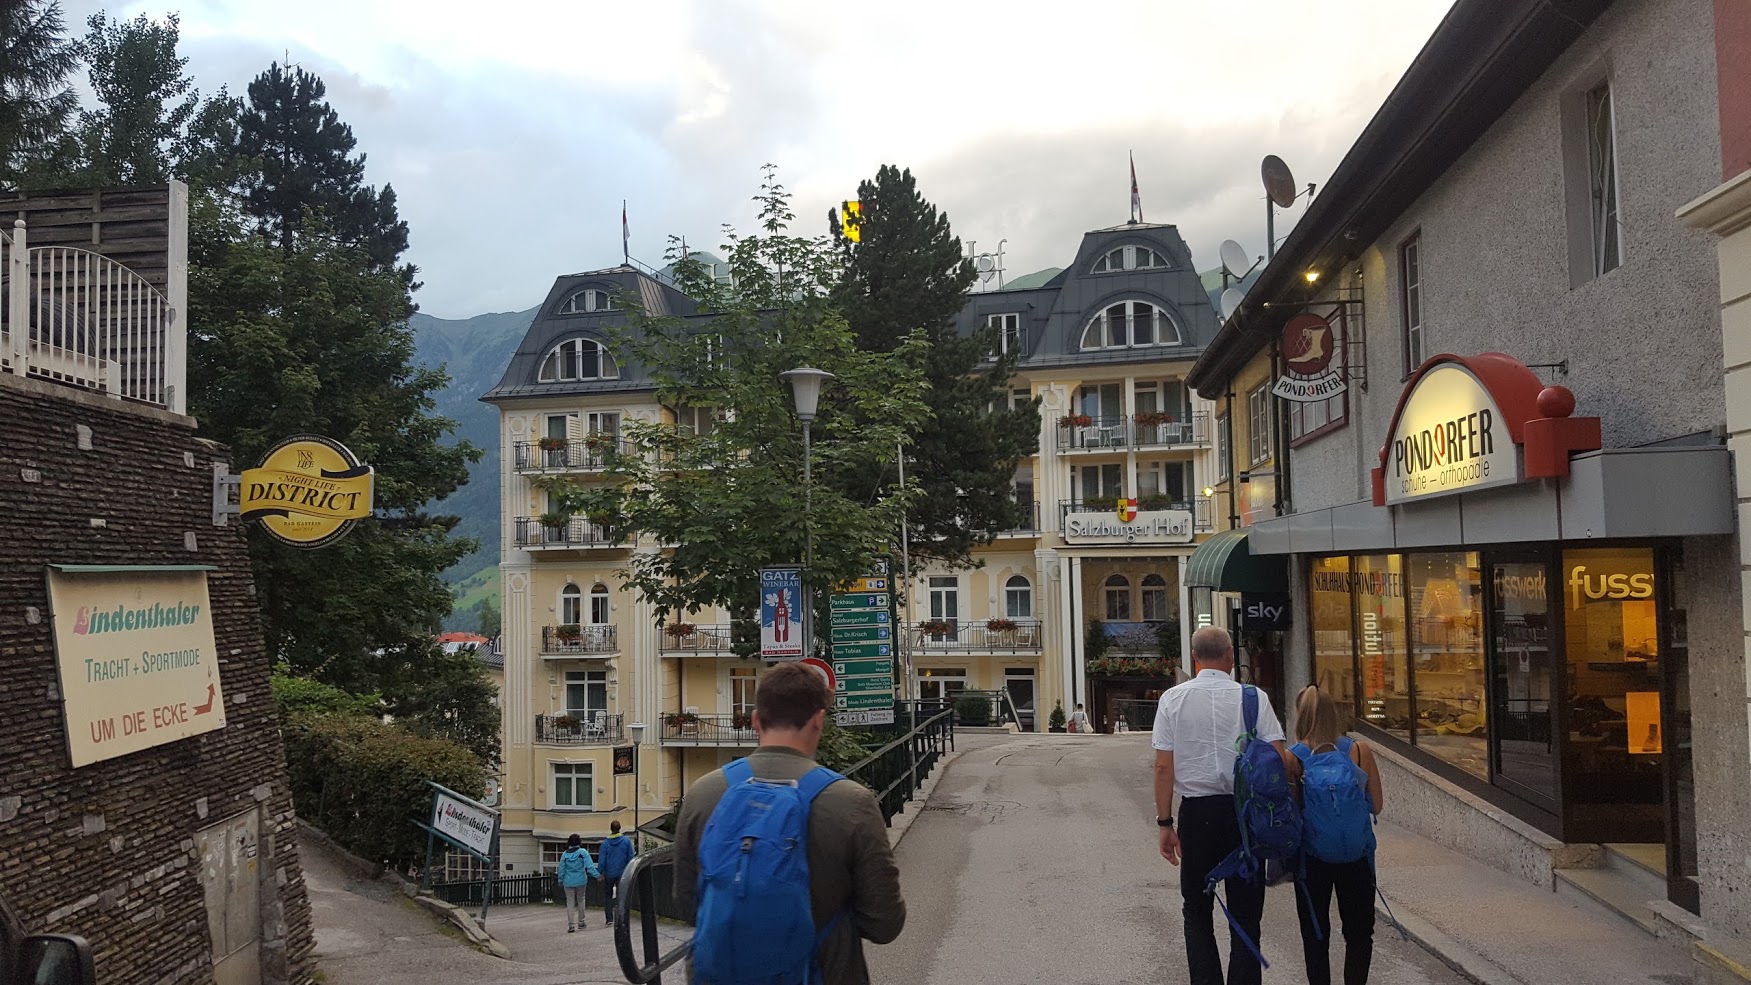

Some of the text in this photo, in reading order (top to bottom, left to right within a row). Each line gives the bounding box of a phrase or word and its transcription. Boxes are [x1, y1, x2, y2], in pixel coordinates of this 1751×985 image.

[1278, 377, 1341, 397] PONDORFER
[1395, 408, 1494, 478] PONDORFER
[283, 475, 336, 490] NIGHT LIFE
[1401, 473, 1427, 494] schuhe
[1439, 459, 1490, 487] orthopädie
[247, 482, 362, 511] DISTRICT
[1069, 518, 1188, 542] Salzburger Hof
[762, 571, 800, 581] GATZ
[1493, 567, 1546, 608] fusswerk
[1568, 566, 1654, 612] fuss
[72, 601, 200, 635] Lindenthaler
[1247, 602, 1284, 622] sky
[85, 648, 200, 683] TRACHT + SPORTMODE
[90, 702, 188, 744] UM DIE ECKE
[445, 803, 491, 835] Lindenthaler
